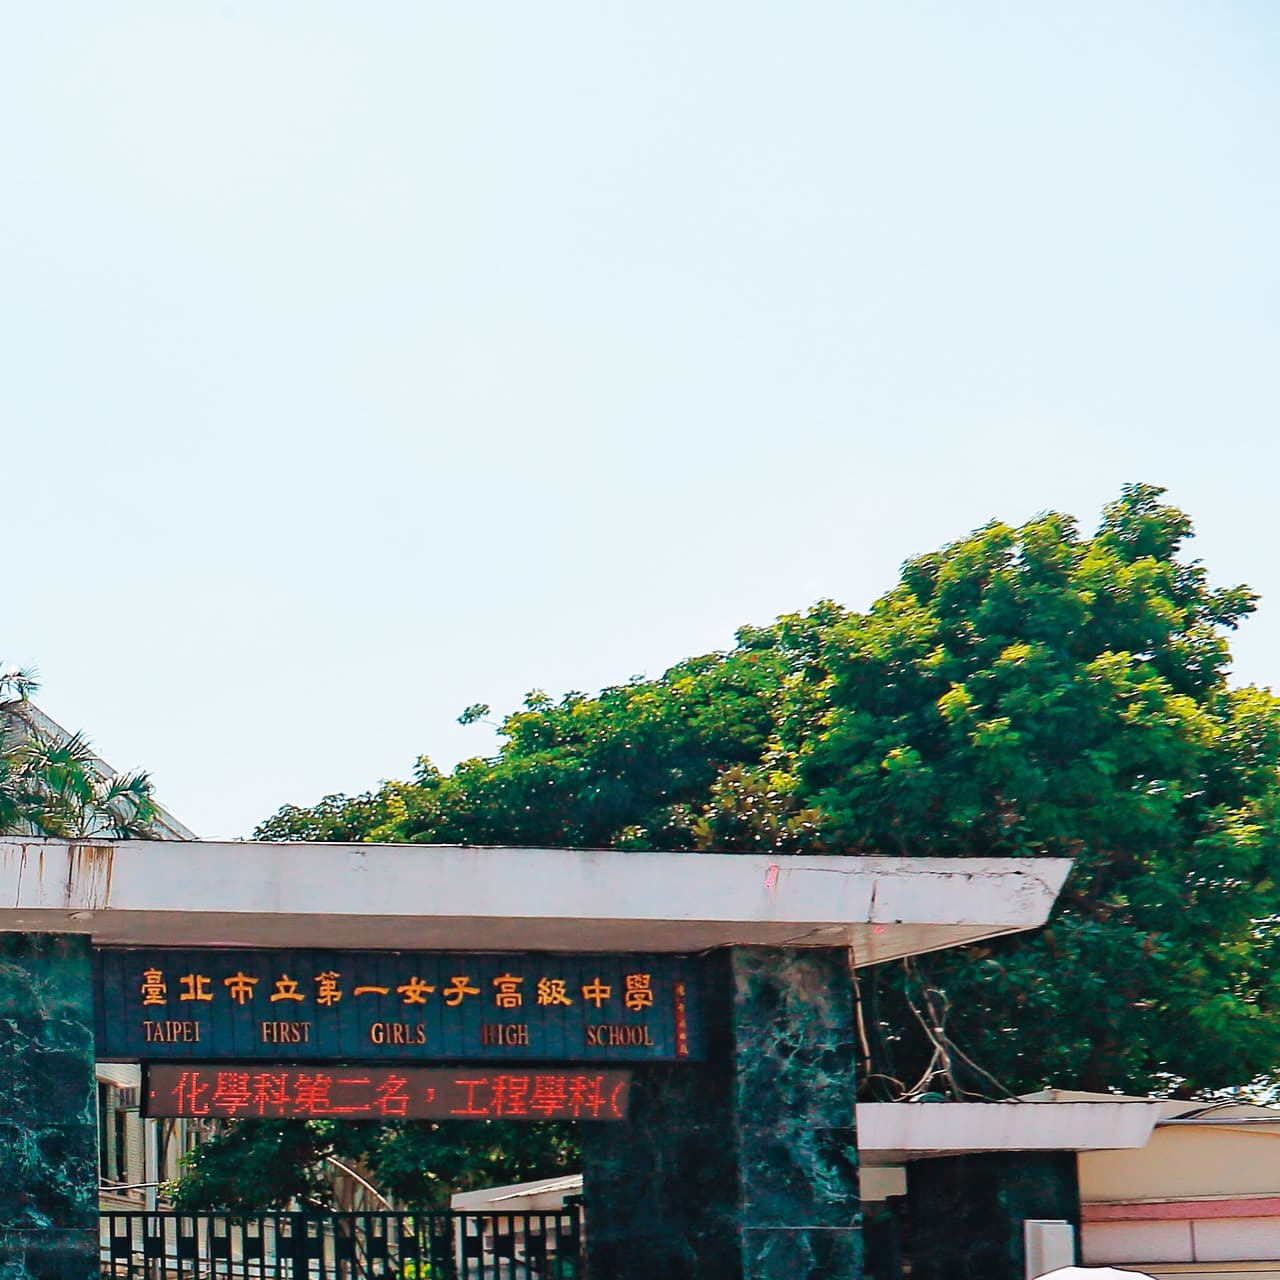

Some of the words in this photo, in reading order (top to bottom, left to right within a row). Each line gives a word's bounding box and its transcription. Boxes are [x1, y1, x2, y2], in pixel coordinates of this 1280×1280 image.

[141, 967, 653, 1011] 臺北市立第一女子高級中學
[143, 1021, 201, 1042] TAIPEI
[261, 1022, 312, 1043] FIRST
[370, 1022, 426, 1044] GIRLS
[482, 1024, 528, 1046] HIGH
[587, 1024, 653, 1046] SCHOOL
